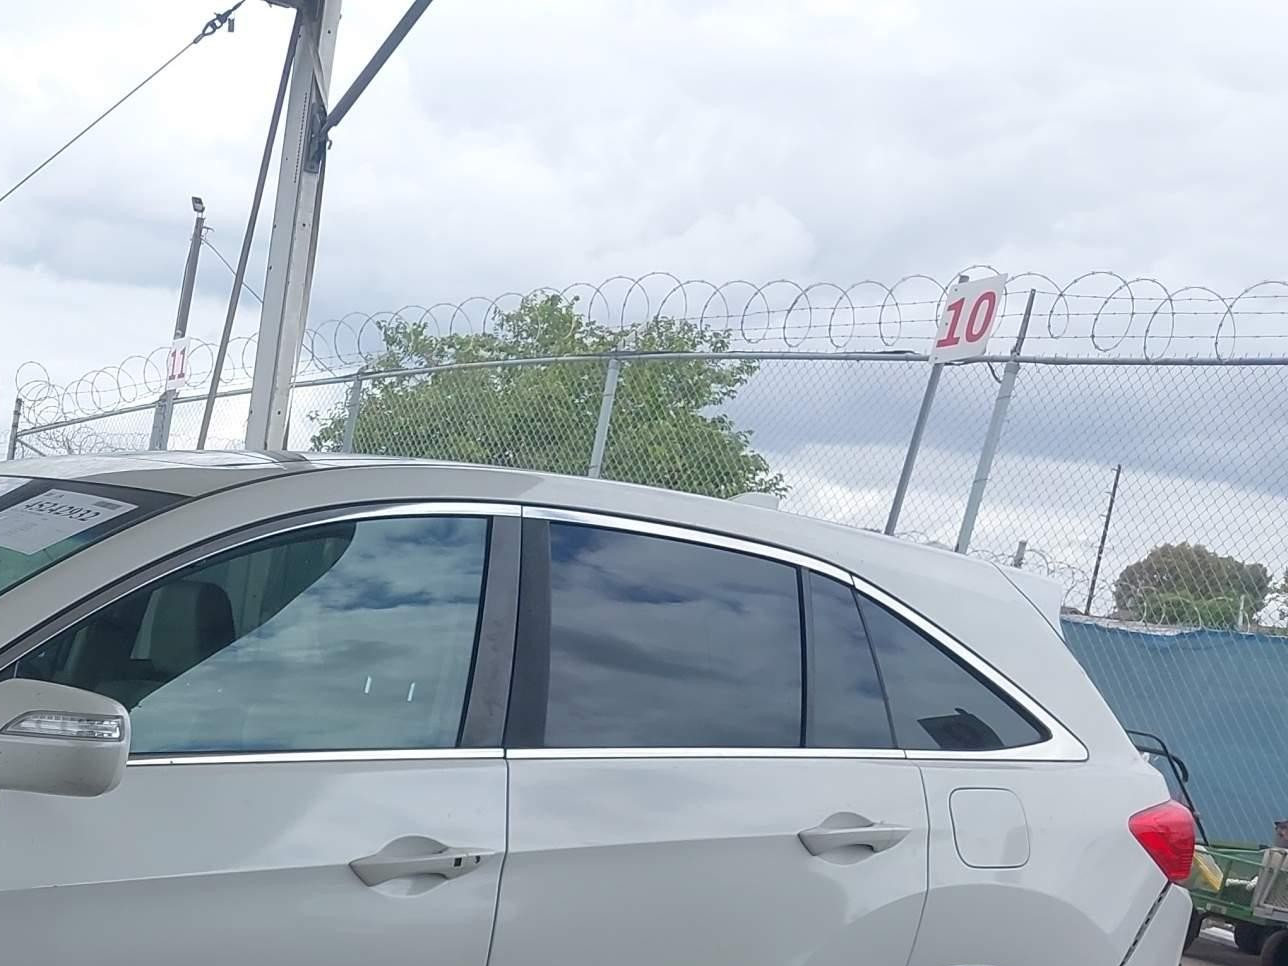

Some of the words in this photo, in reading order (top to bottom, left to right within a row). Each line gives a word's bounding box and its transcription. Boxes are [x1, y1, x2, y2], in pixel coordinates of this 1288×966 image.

[936, 291, 996, 348] 10
[169, 346, 186, 380] 11
[24, 500, 101, 522] 45242932
